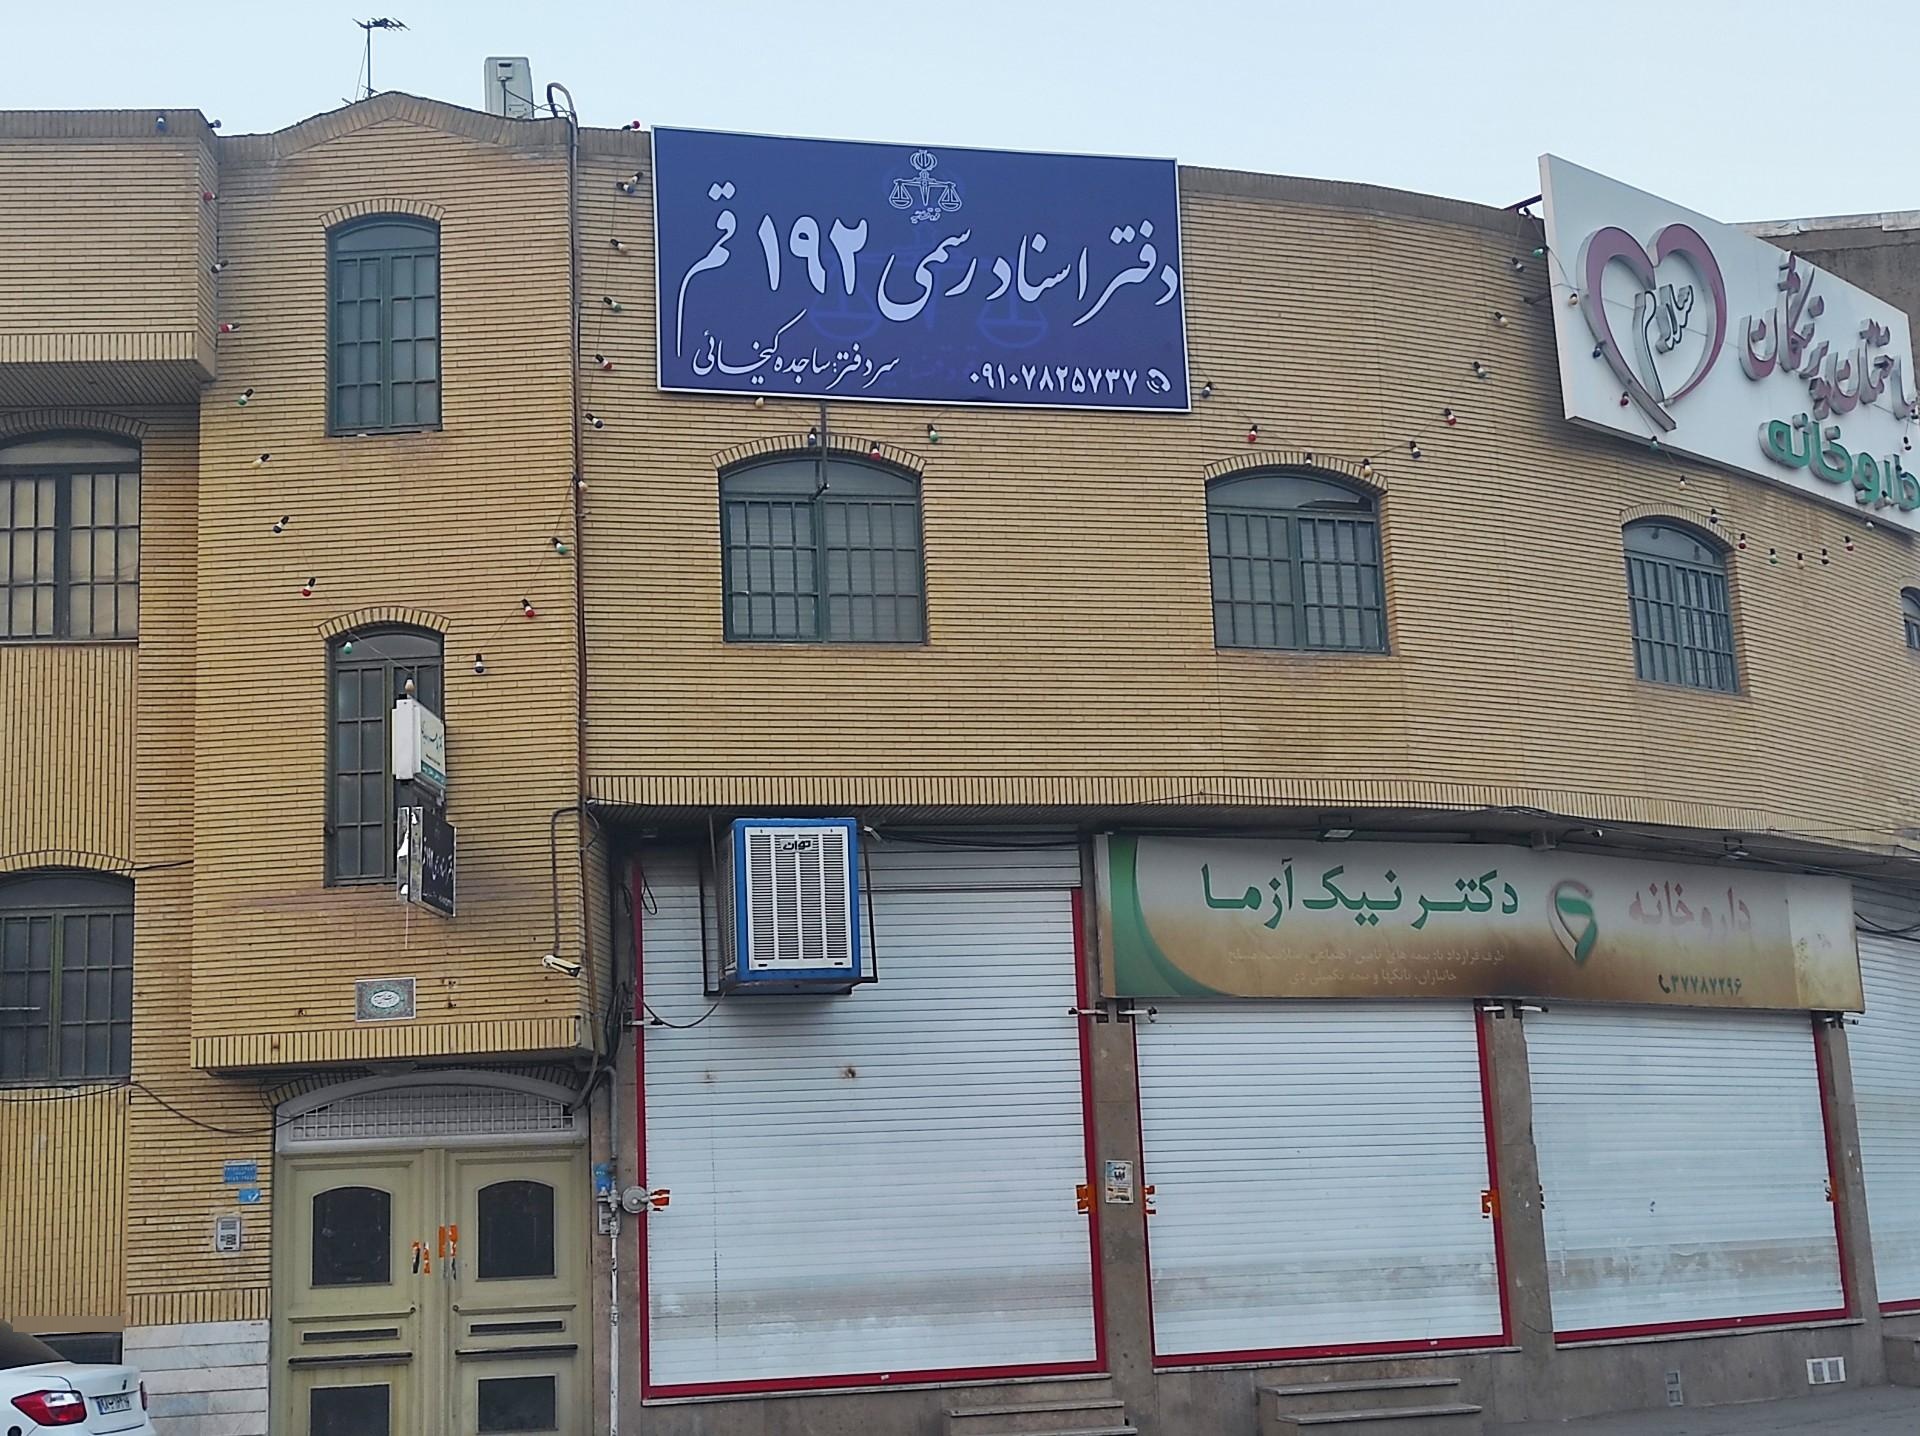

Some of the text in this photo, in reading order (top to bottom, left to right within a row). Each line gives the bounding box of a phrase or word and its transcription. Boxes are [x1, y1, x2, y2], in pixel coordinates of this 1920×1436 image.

[676, 180, 1179, 358] دفتر اسناد رسمی ۱۹۲ قم
[773, 346, 831, 384] ساجده
[969, 362, 1138, 396] ۰۹۱۰۷۸۲۵۷۳۷
[1200, 857, 1294, 931] آزما
[1302, 865, 1403, 927] نیک
[1410, 868, 1519, 931] دکتر
